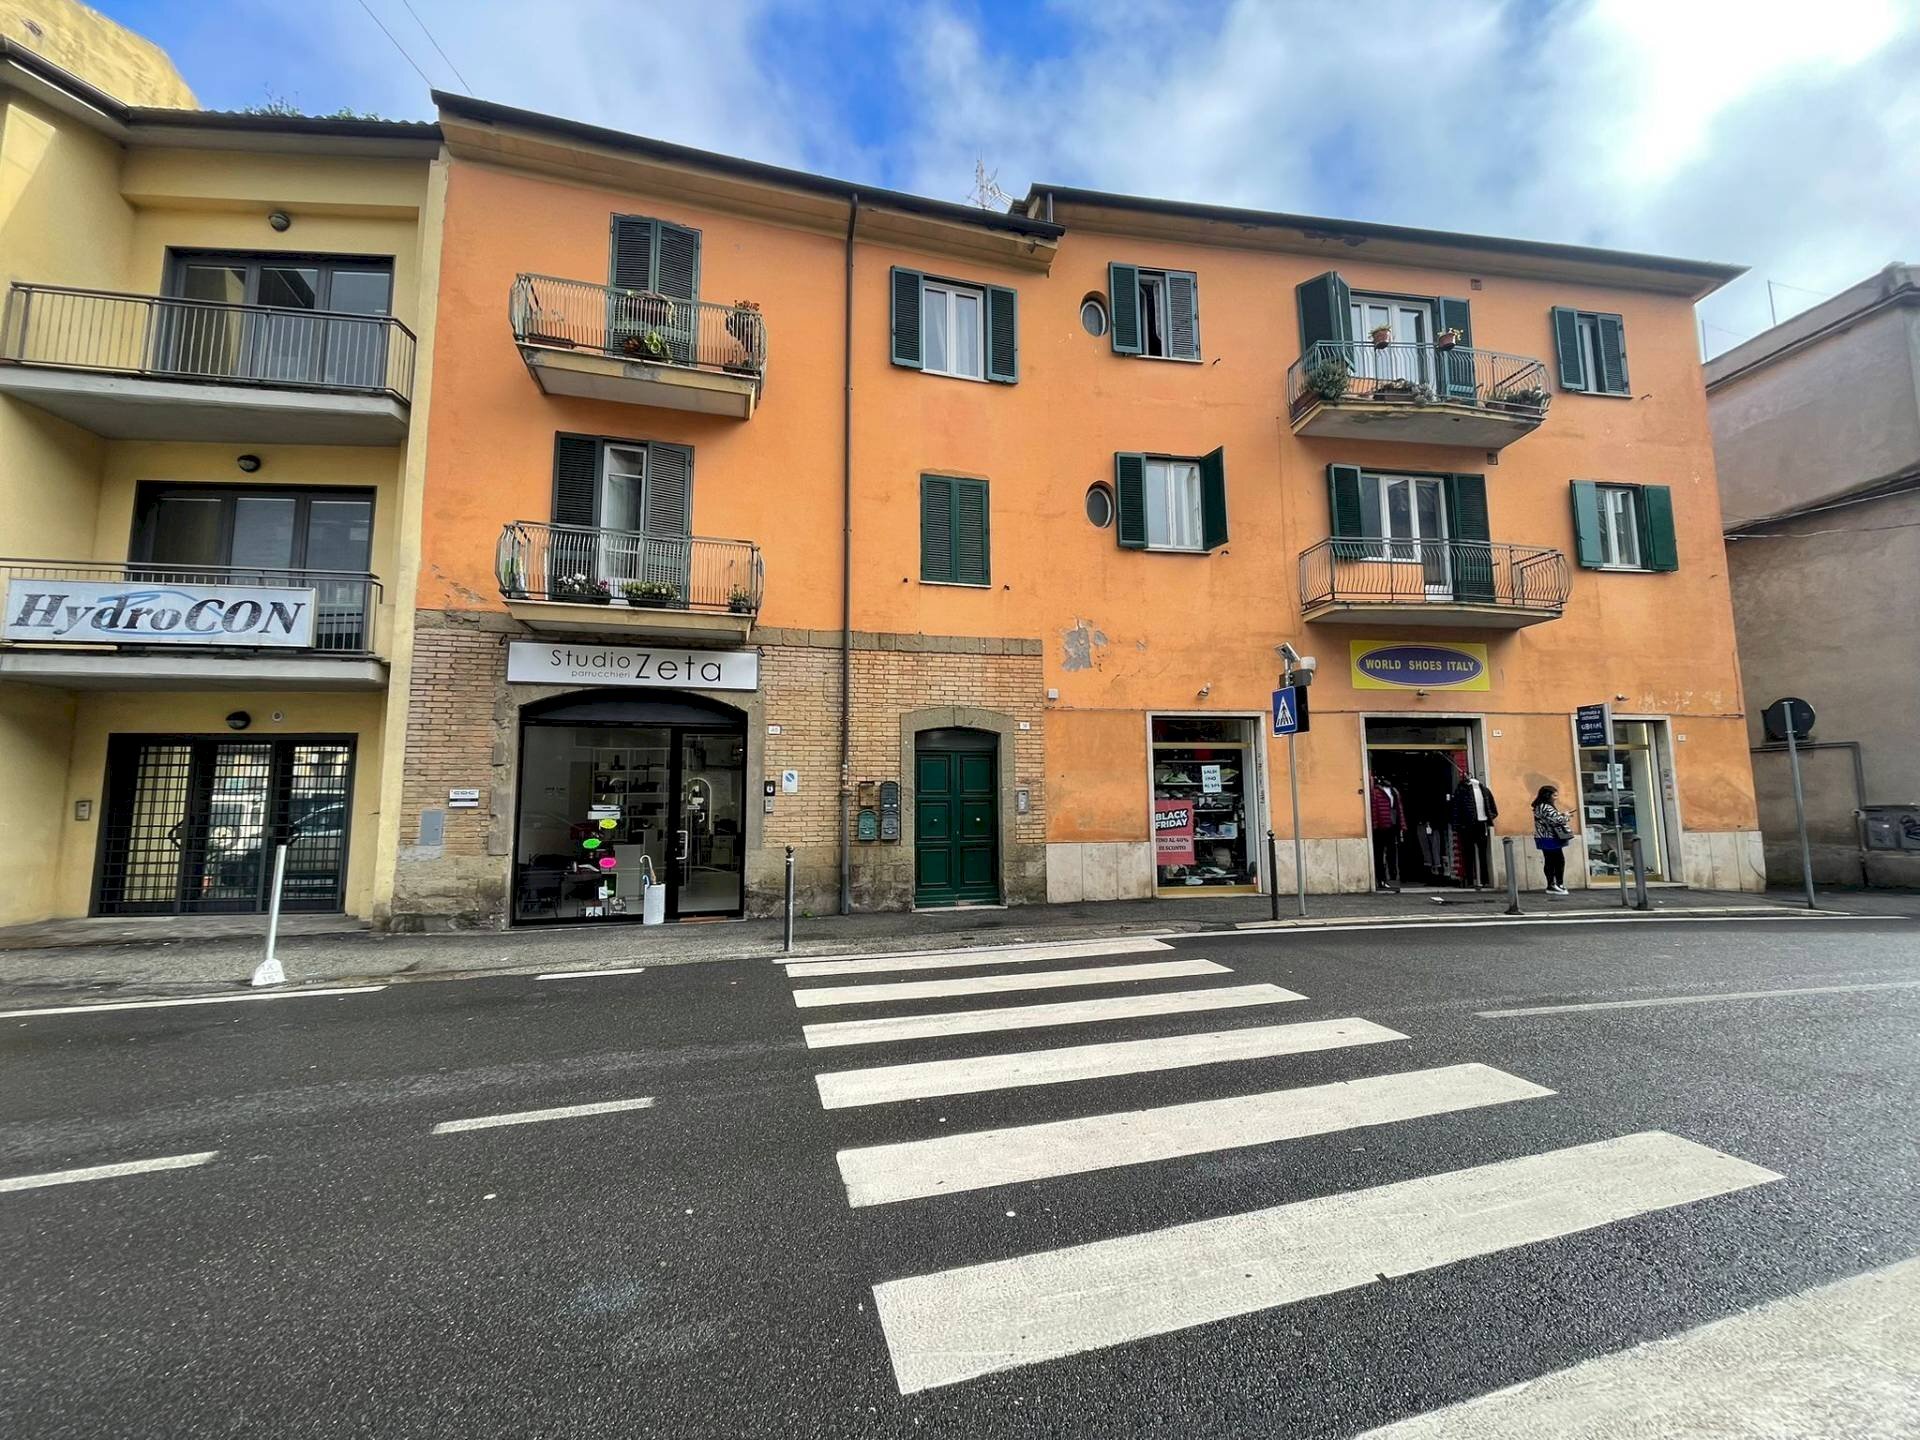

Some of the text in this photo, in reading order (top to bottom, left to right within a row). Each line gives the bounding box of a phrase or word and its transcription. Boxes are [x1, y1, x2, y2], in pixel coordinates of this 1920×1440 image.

[10, 594, 305, 635] HydroCON
[550, 649, 721, 682] Studio Zeta
[1365, 659, 1474, 671] WORLD SHOES ITALY
[571, 669, 630, 678] parrucchieri
[1156, 810, 1188, 821] BLACK
[1155, 818, 1188, 829] FRIDAY
